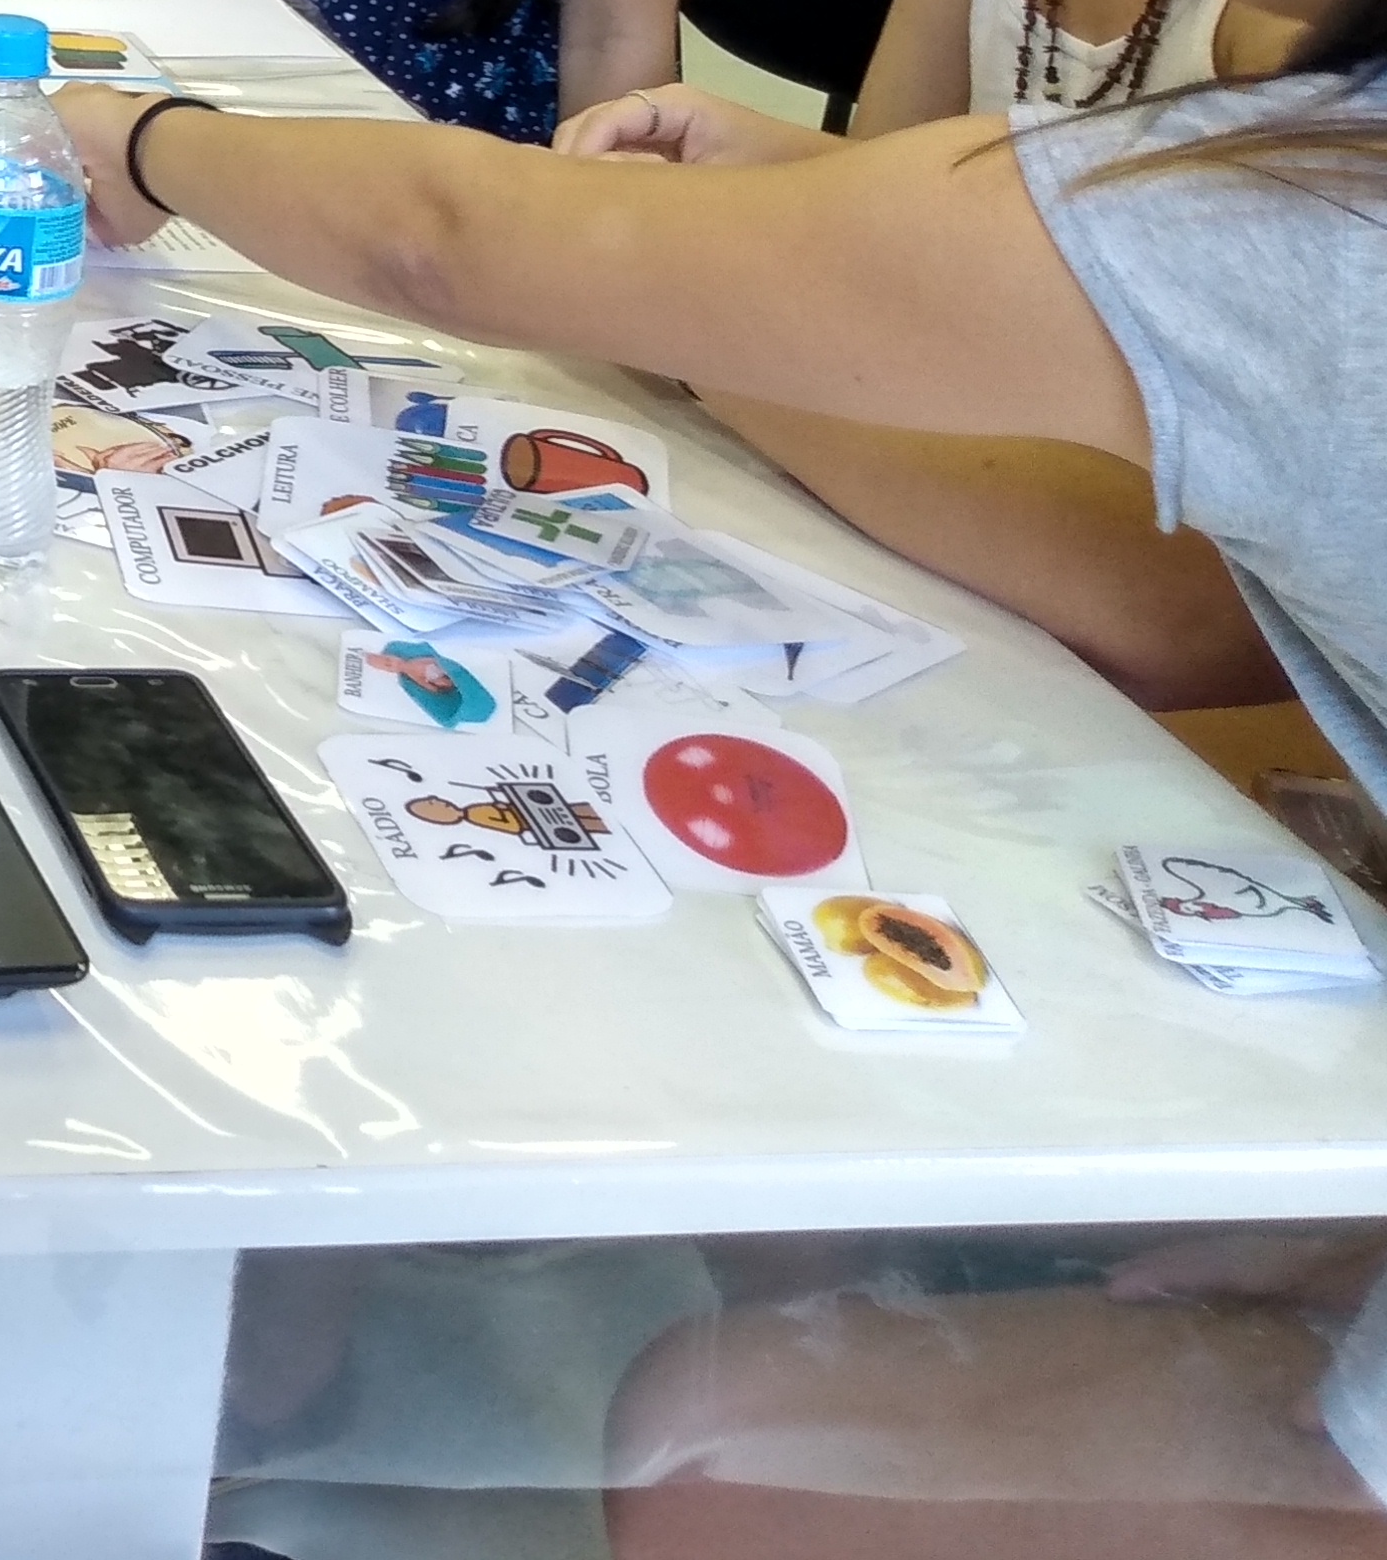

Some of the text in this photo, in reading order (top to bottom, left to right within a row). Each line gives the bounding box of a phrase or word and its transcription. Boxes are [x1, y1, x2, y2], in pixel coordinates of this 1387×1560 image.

[55, 375, 121, 414] CADEIRA
[271, 443, 299, 504] LEITURA
[111, 486, 163, 586] COMPUTADOR
[343, 646, 365, 698] BANHEIRA
[361, 796, 419, 861] RÁDIO
[783, 918, 835, 979] MAMÃO
